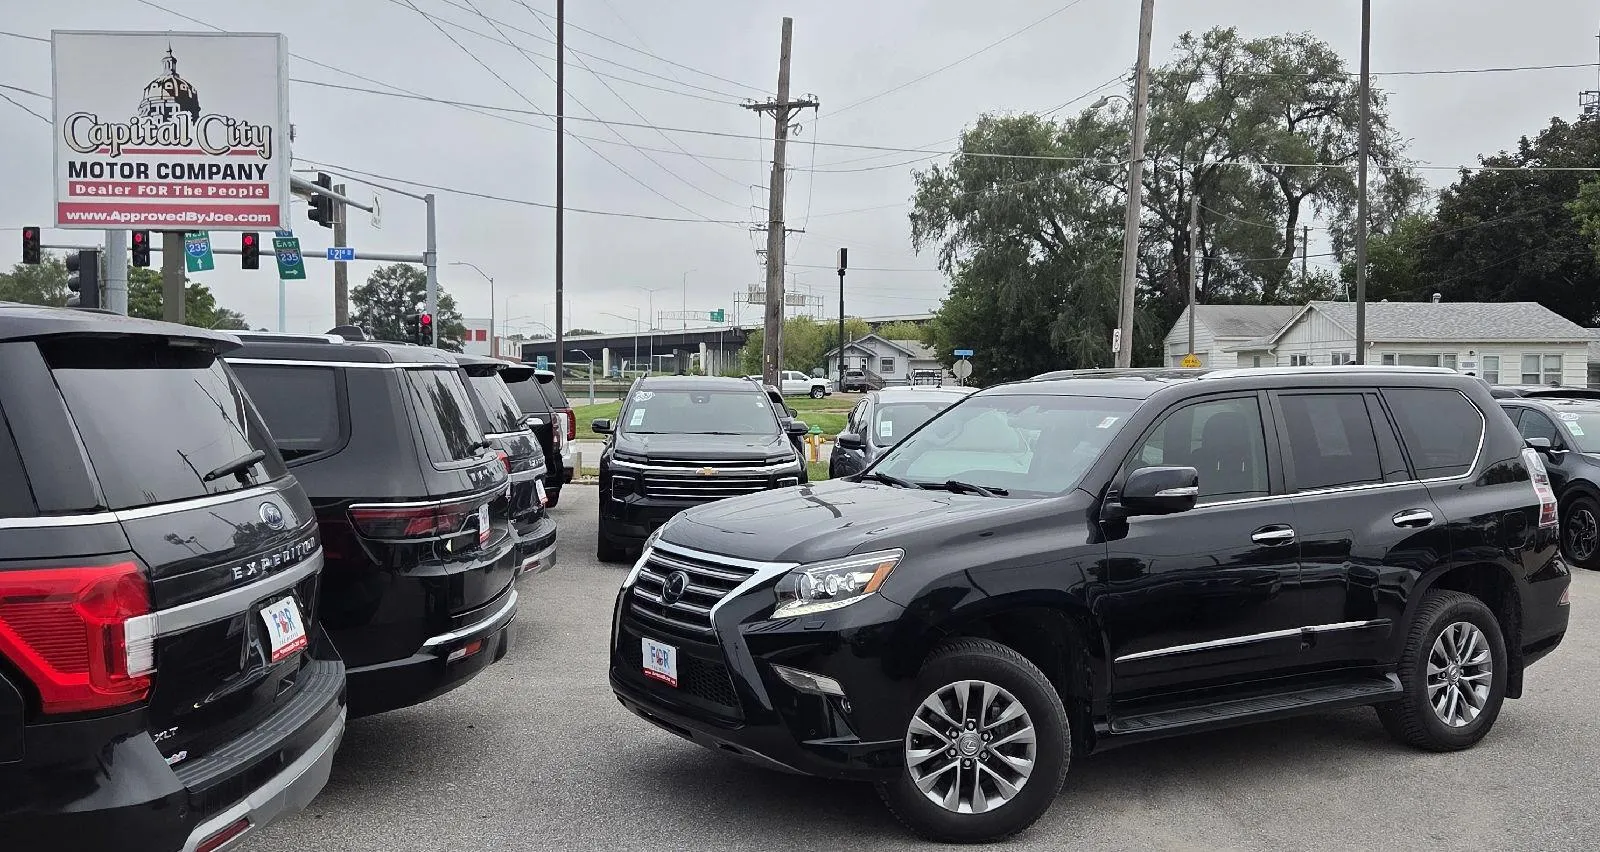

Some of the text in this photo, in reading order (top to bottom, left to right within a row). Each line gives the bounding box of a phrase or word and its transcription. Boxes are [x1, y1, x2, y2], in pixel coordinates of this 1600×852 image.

[64, 112, 272, 160] Capital City
[68, 161, 268, 180] MOTOR COMPANY
[75, 184, 265, 198] Dealer FOR The People
[66, 210, 270, 223] www.ApprovedByJoe.com
[189, 243, 207, 252] 235
[281, 253, 298, 261] 235
[154, 726, 179, 743] XLT
